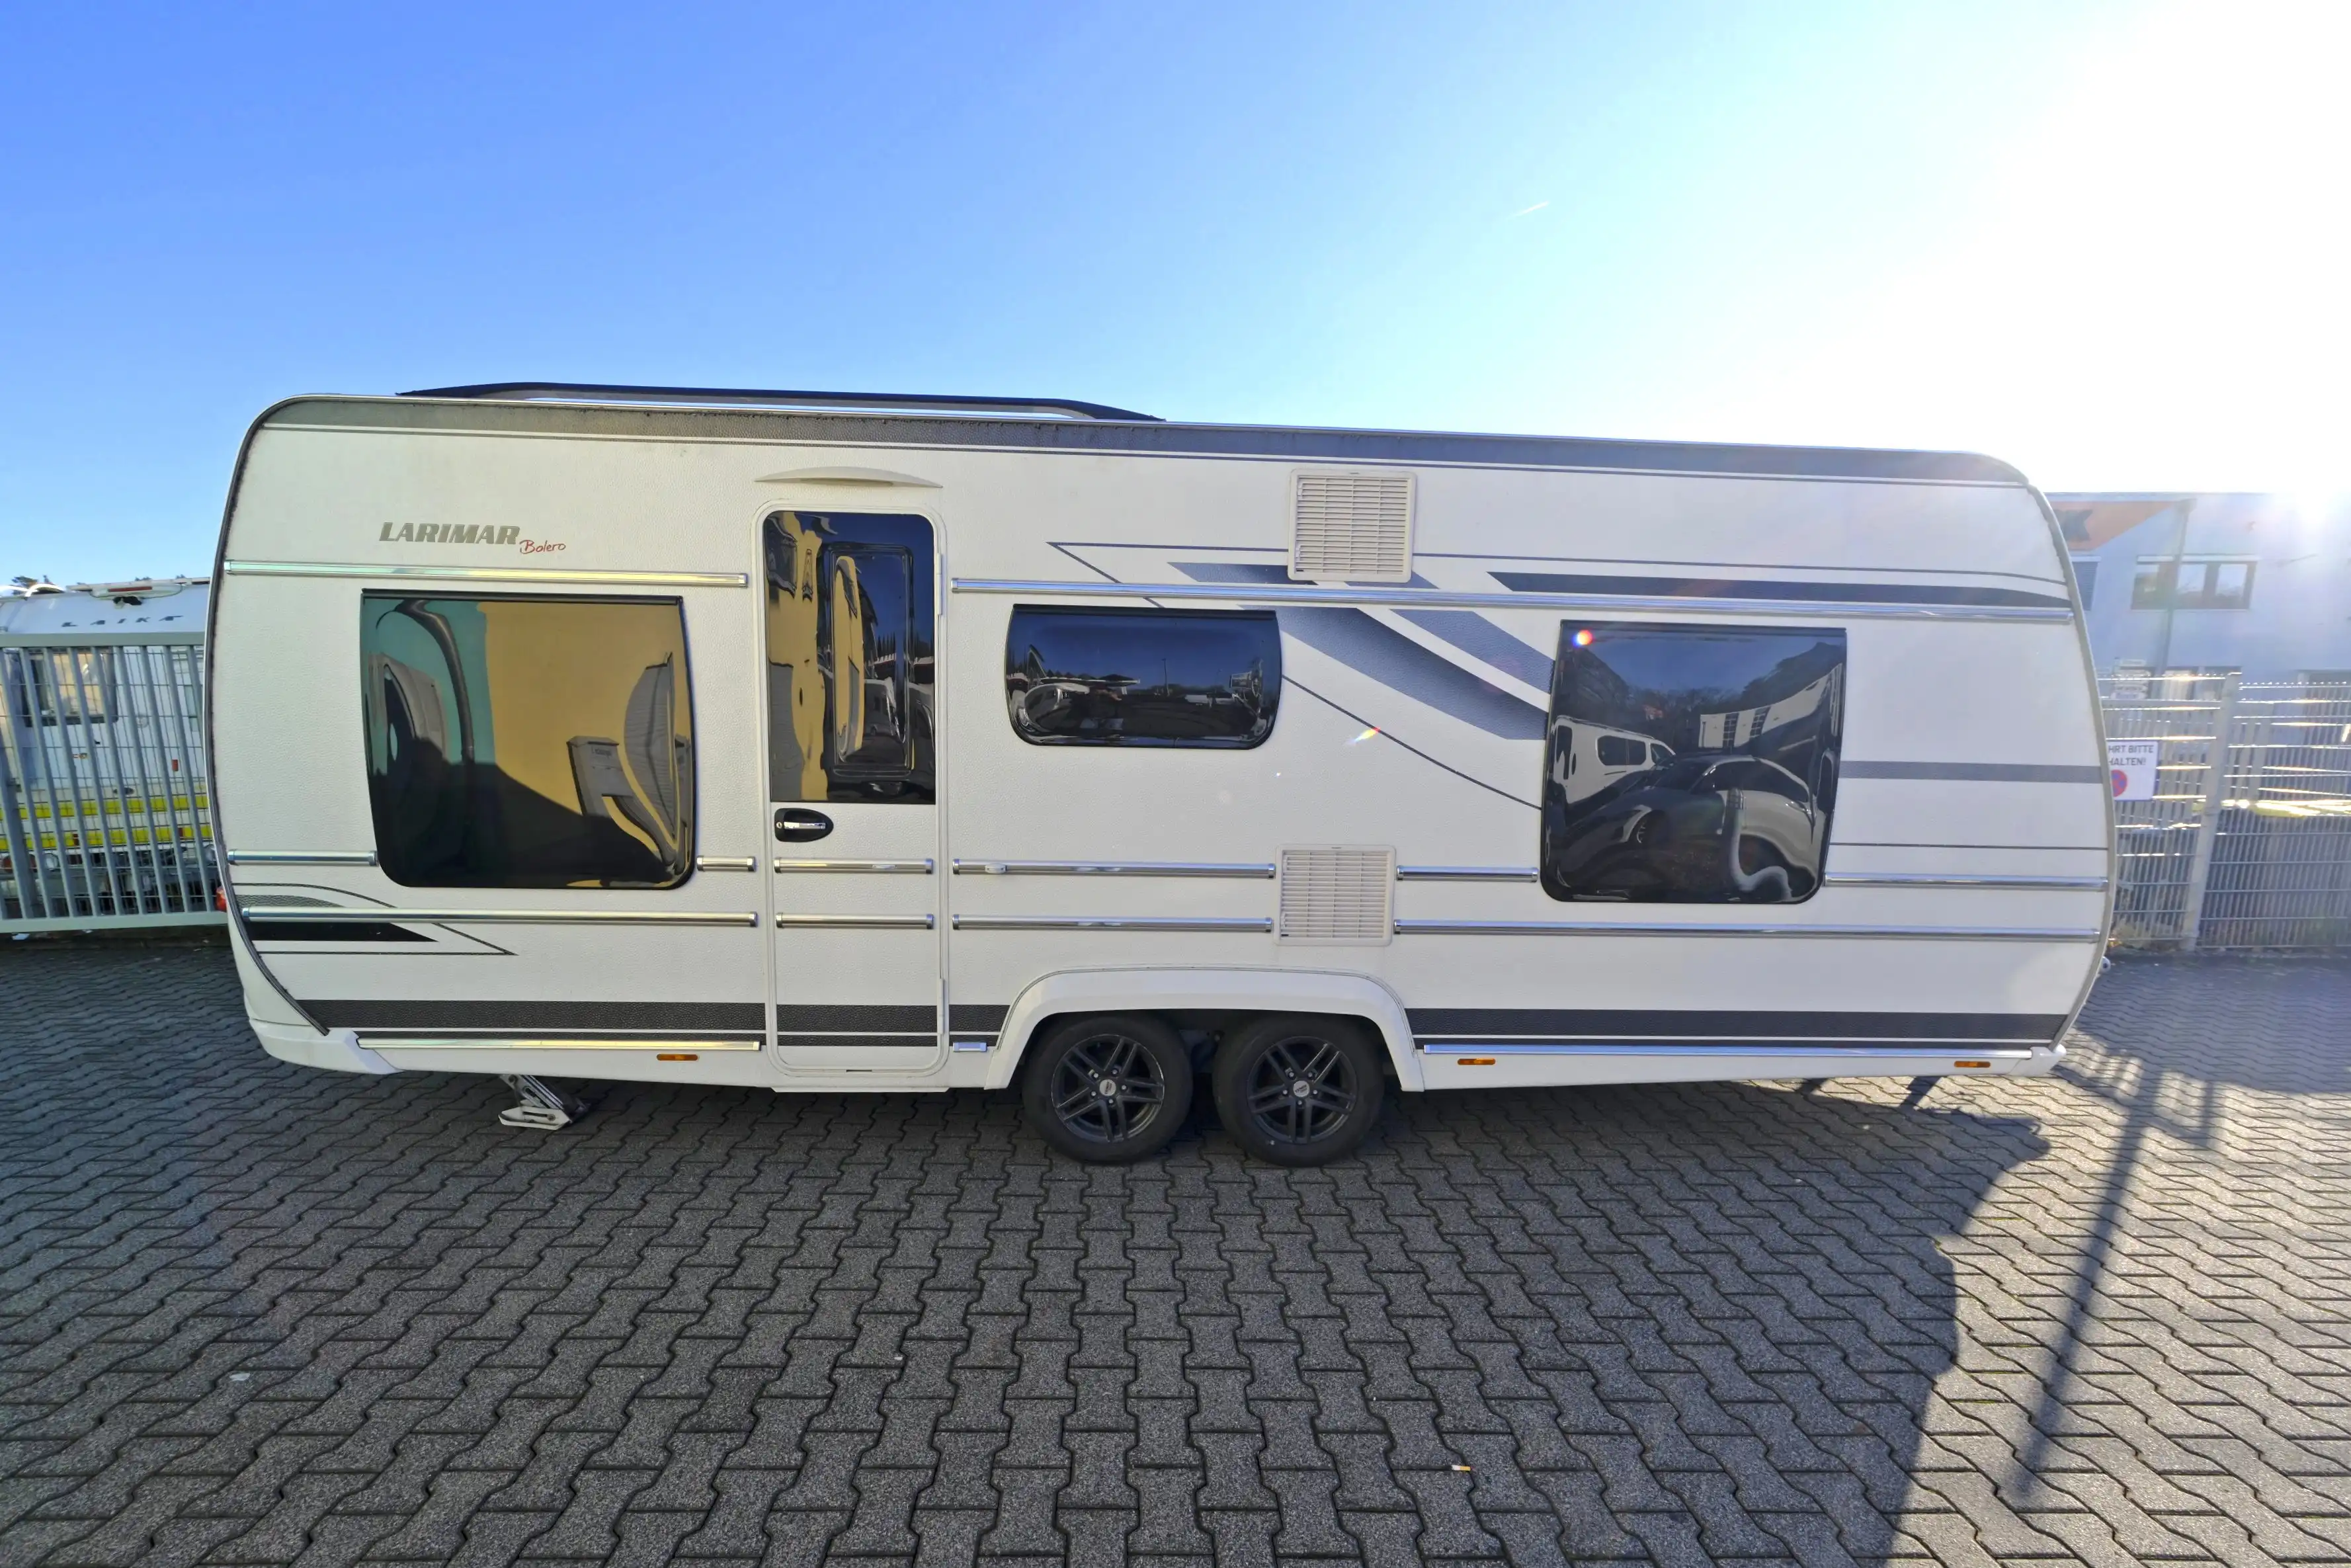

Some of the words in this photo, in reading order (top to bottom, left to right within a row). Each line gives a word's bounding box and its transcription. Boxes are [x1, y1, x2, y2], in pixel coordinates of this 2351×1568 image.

[379, 522, 520, 544] LARIMAR
[520, 540, 566, 554] Bolero
[2128, 745, 2154, 753] BITTE
